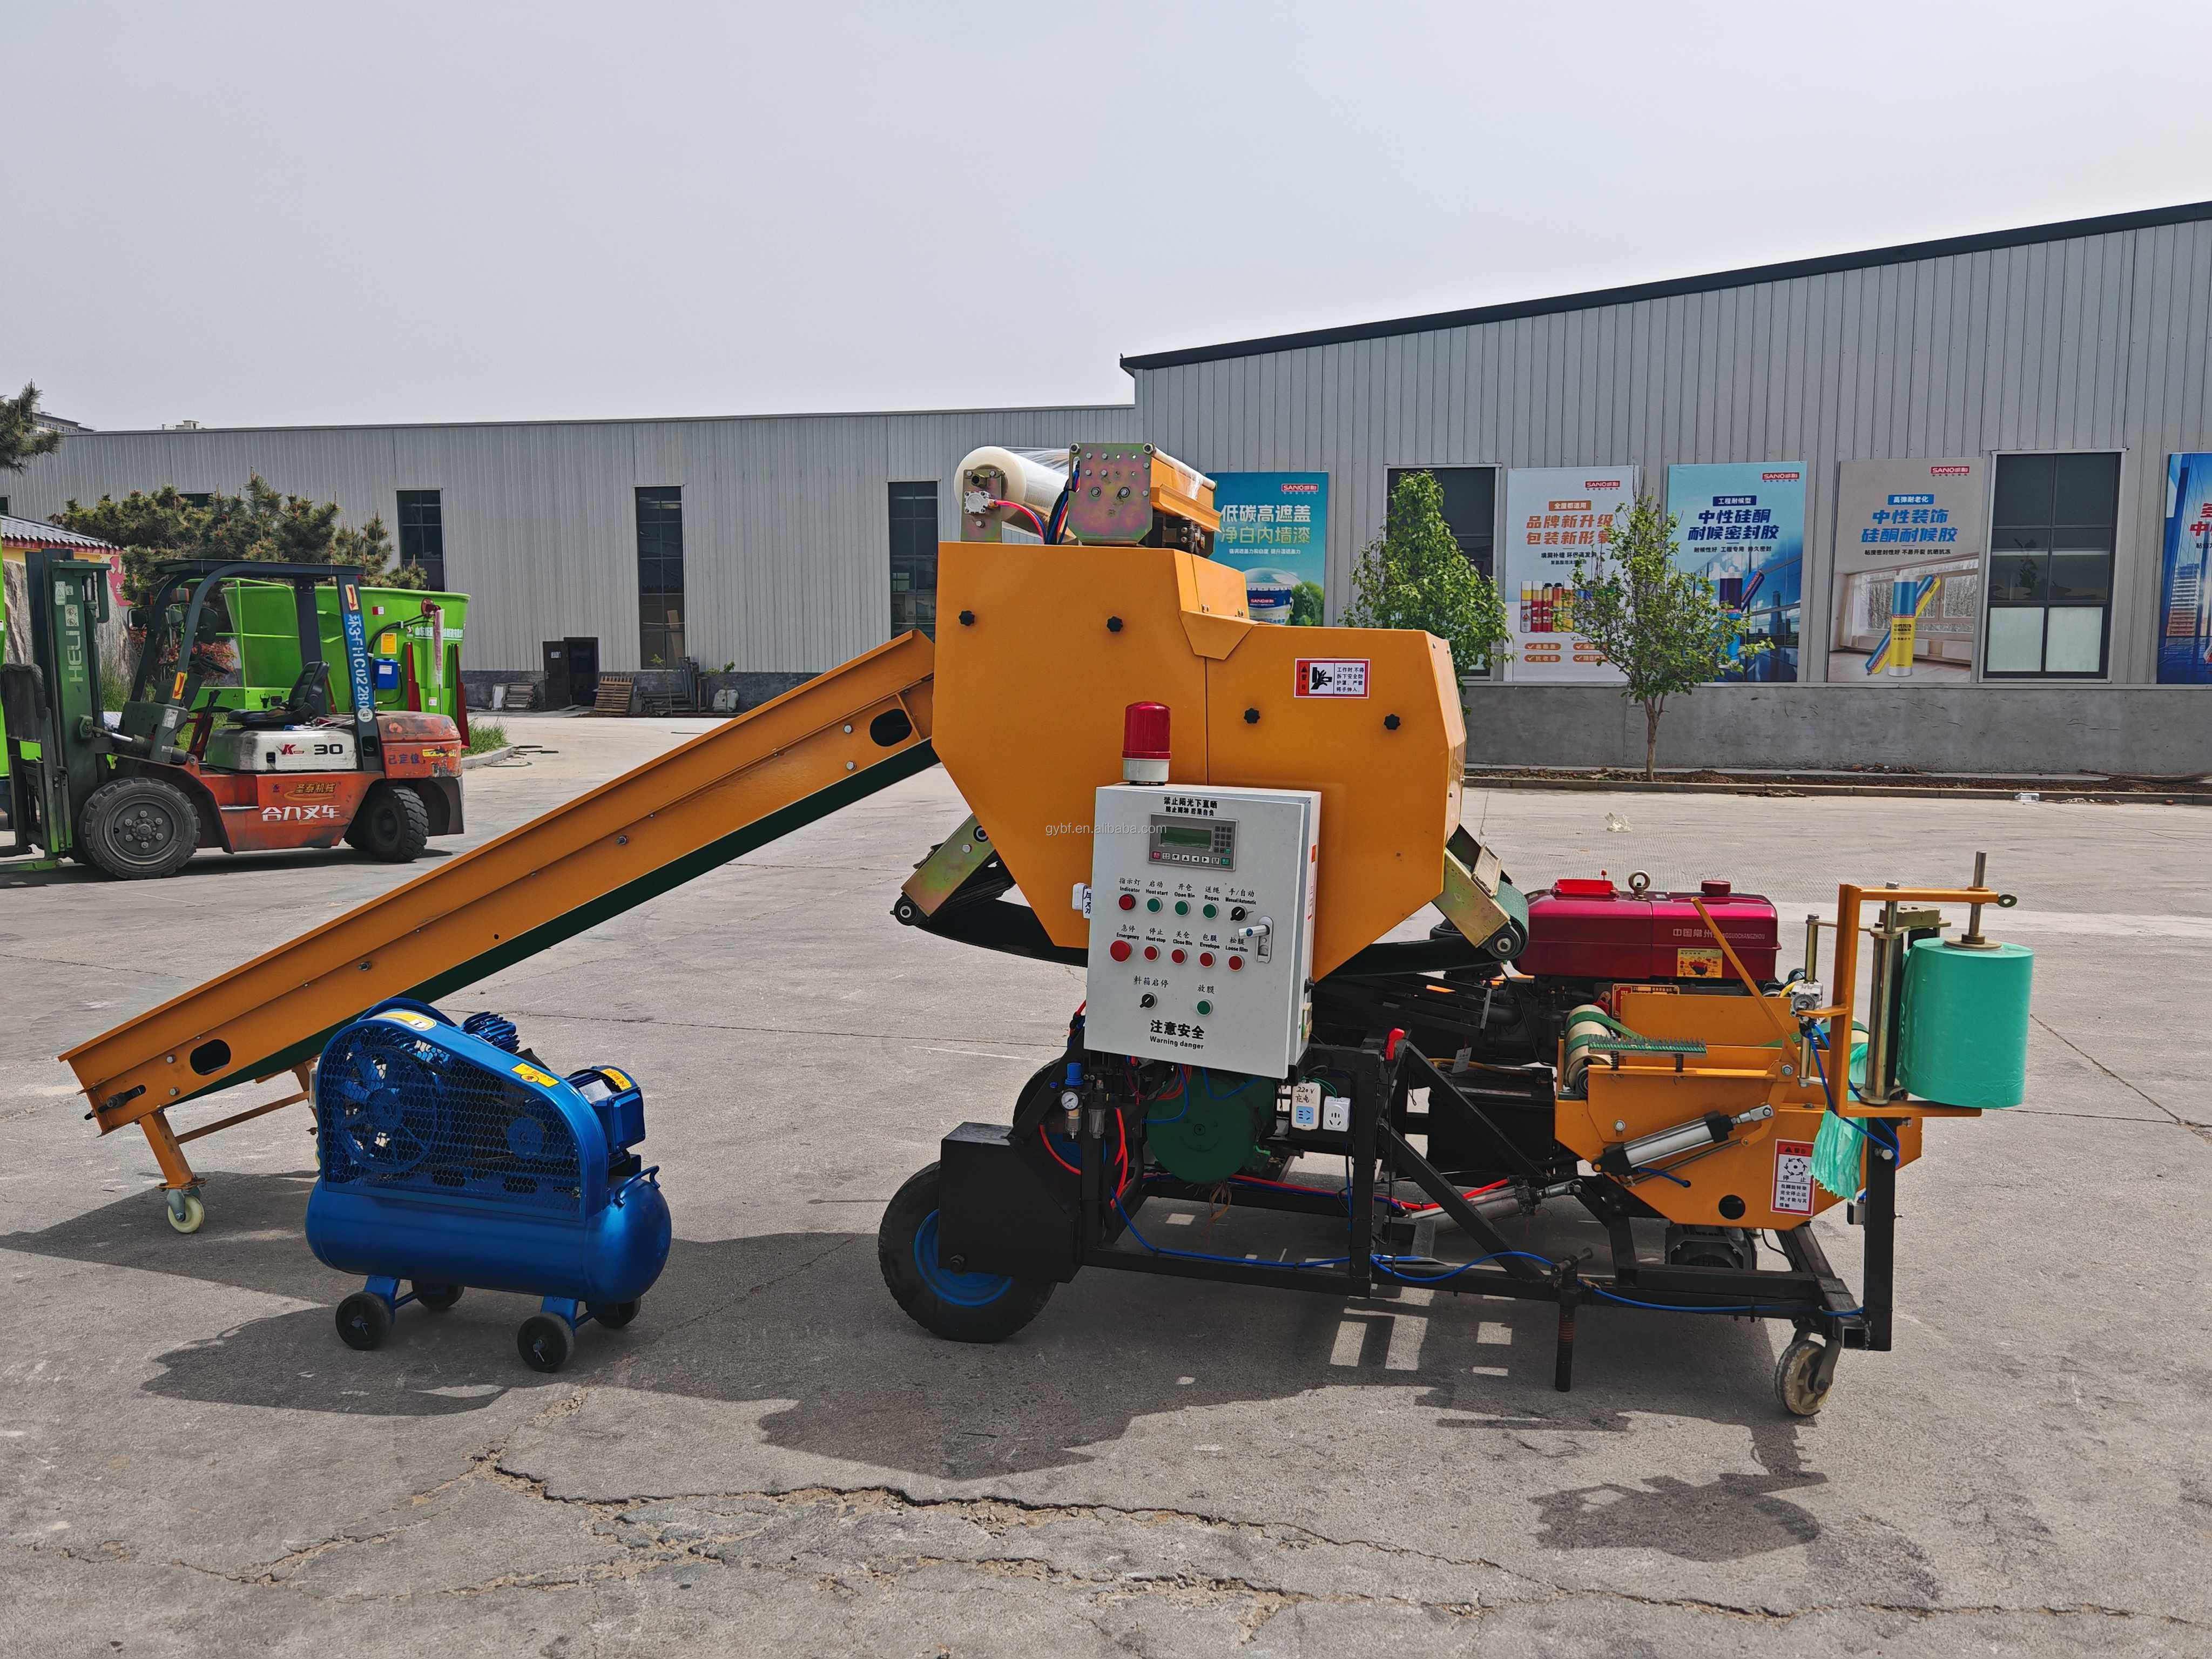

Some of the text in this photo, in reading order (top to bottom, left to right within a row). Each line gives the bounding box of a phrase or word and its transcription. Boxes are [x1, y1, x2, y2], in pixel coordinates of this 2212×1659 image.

[1220, 504, 1311, 522] 低碳高遮盖
[1698, 509, 1771, 524] 中性硅酮
[1872, 509, 1949, 524] 中性装饰
[1526, 514, 1614, 529] 品牌新升级
[1220, 526, 1311, 544] 净白内墙漆
[1526, 530, 1611, 544] 包装新形象
[1688, 525, 1780, 540] 耐候密封胶
[1861, 527, 1958, 542] 硅酮耐候胶
[66, 631, 83, 682] HELI
[314, 744, 343, 754] 30
[1164, 797, 1218, 808] 禁止阳光下直晒
[261, 805, 340, 821] 合力叉车
[1119, 877, 1141, 886] 指示灯
[1205, 886, 1220, 894] 送绳
[1229, 888, 1255, 897] 手/自动
[1225, 896, 1257, 905] Manual/Automatic
[1121, 924, 1136, 933] 急停
[1149, 927, 1164, 935] 停止
[1673, 928, 1712, 938] 中国常州
[1116, 932, 1139, 941] Emergency
[1176, 930, 1190, 939] 关仓
[1203, 933, 1218, 942] 包膜
[1197, 984, 1215, 994] 放膜
[1150, 1020, 1204, 1040] 注意安全
[1150, 1036, 1204, 1050] Warning danger
